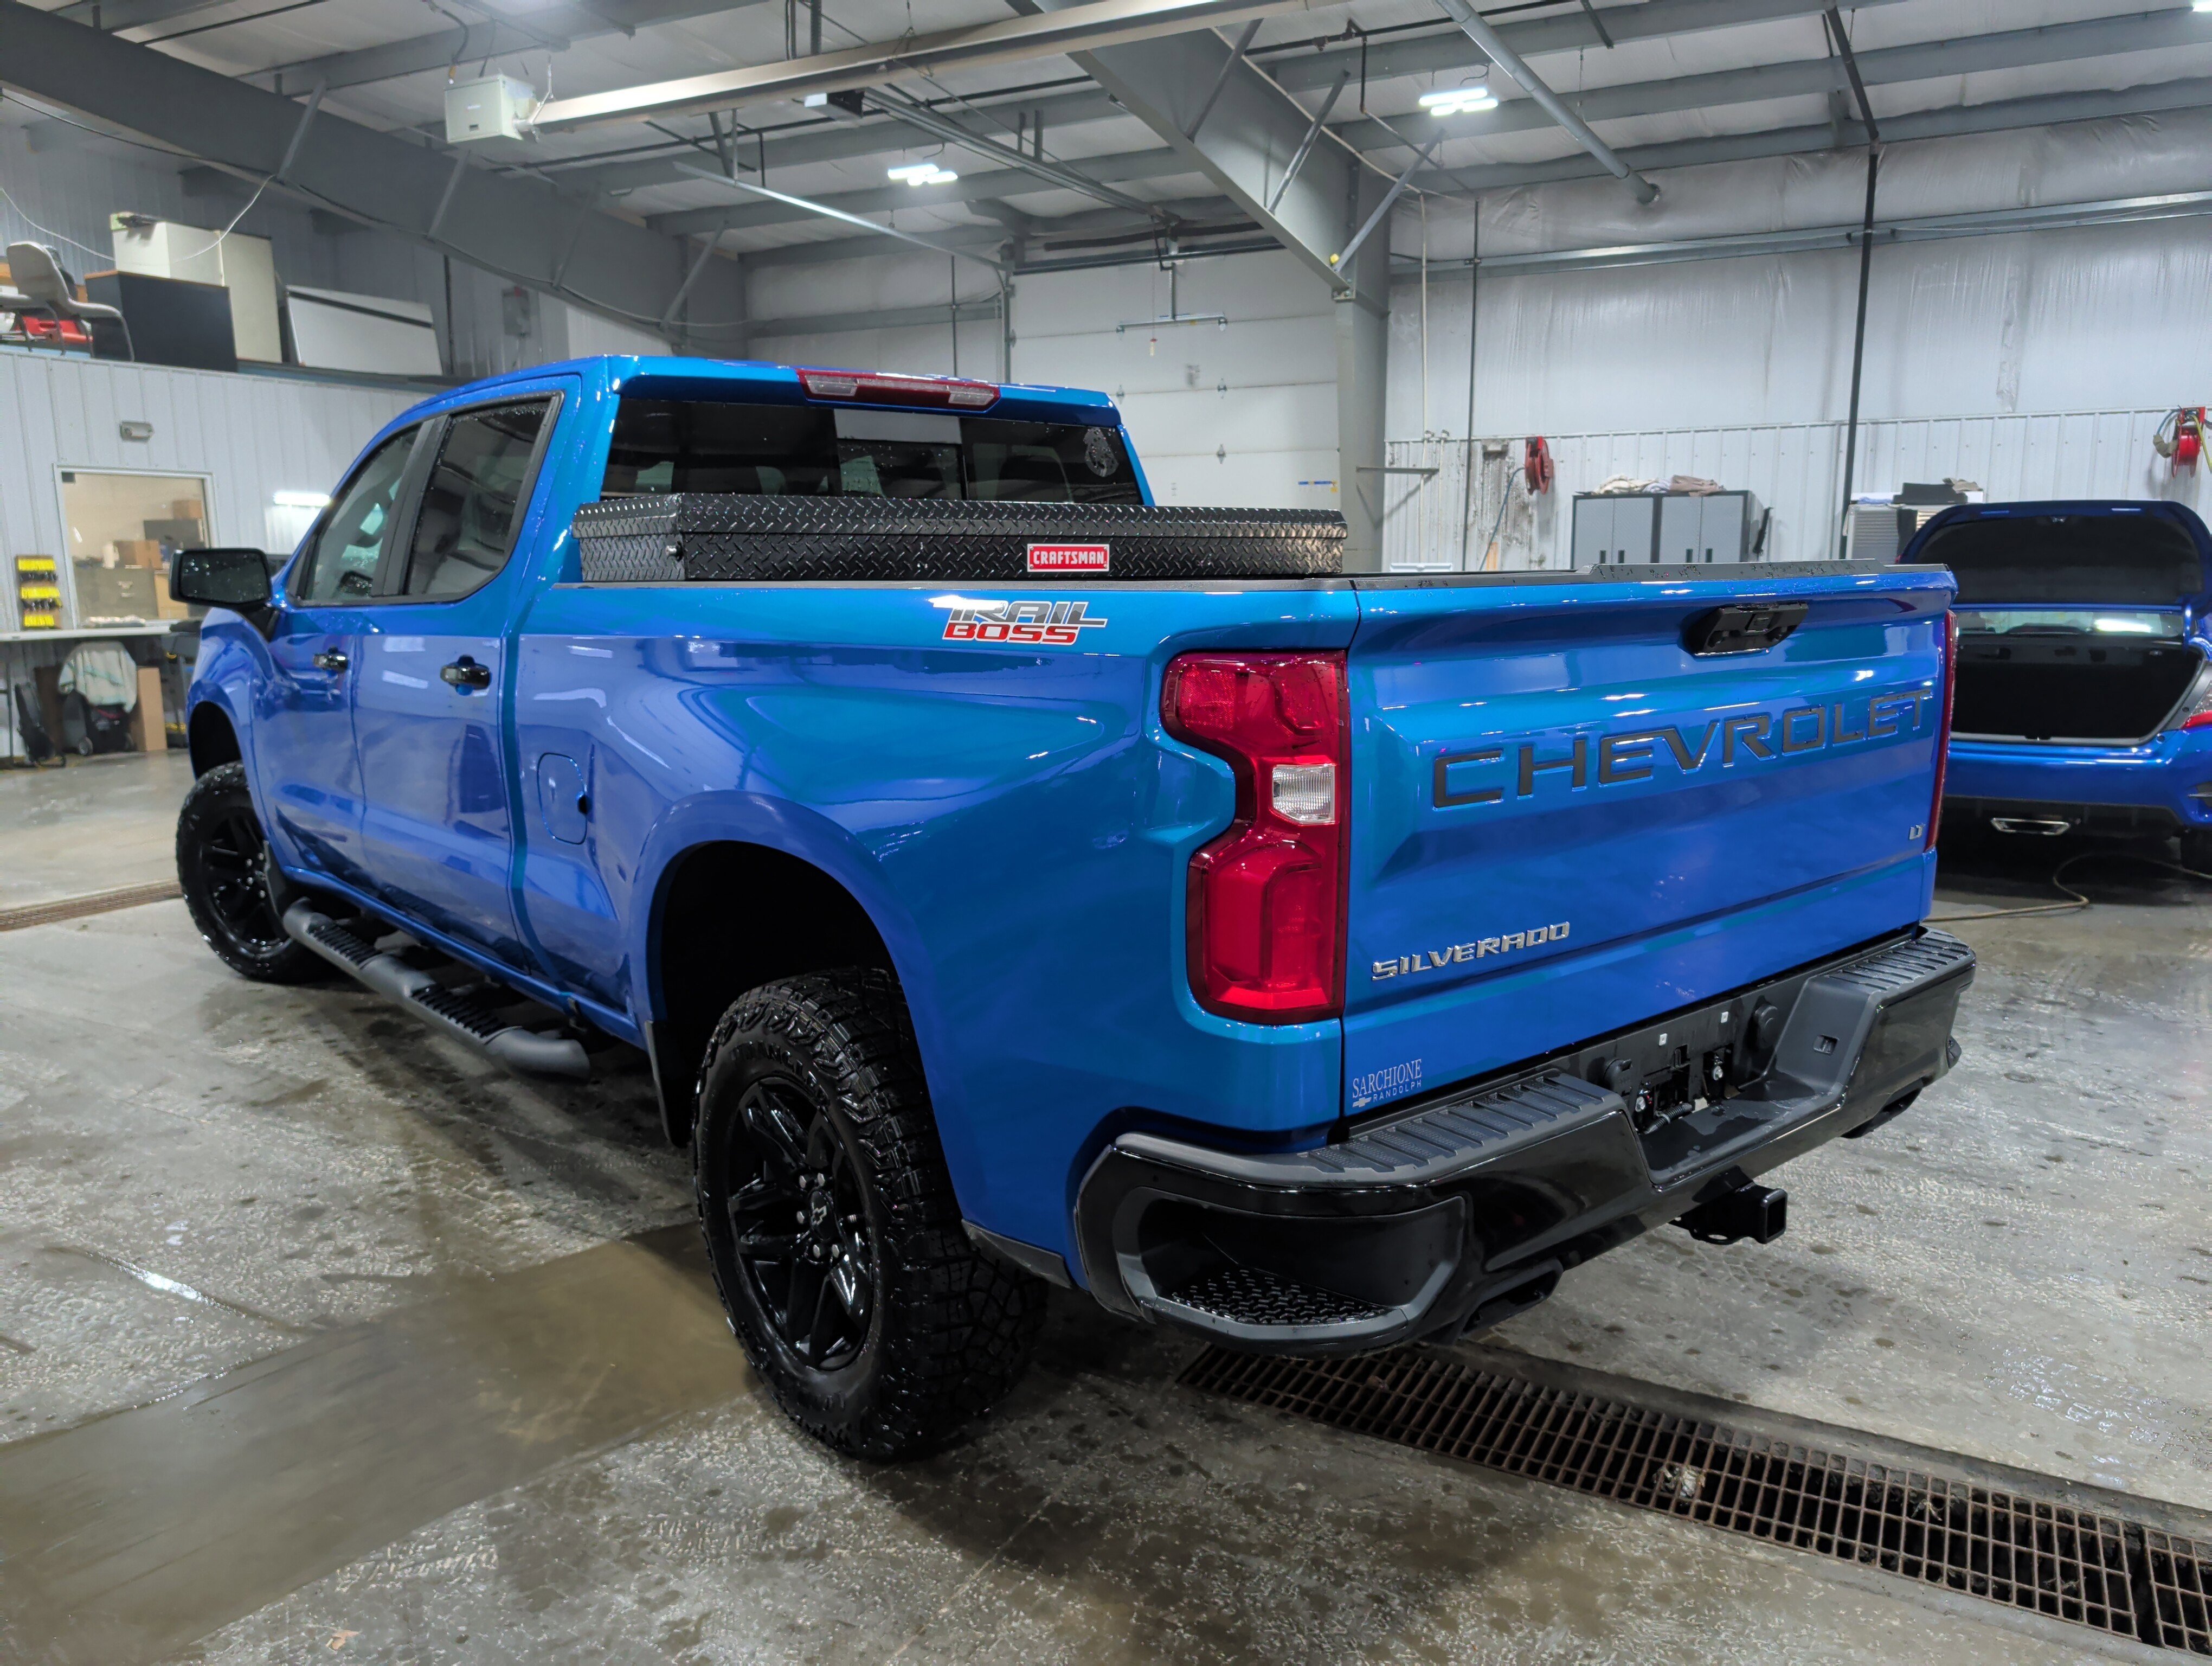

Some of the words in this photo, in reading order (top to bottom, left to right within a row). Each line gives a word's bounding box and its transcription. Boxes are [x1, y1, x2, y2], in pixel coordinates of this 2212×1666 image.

[1032, 550, 1104, 565] CRAFTSMAN
[934, 600, 1108, 628] TRAIL
[942, 622, 1081, 645] BOSS
[1432, 688, 1933, 811] CHEVROLET
[1372, 921, 1570, 981] SILVERADO
[1352, 1058, 1422, 1099] SARCHIONE
[1373, 1079, 1422, 1102] RANDOLPH
